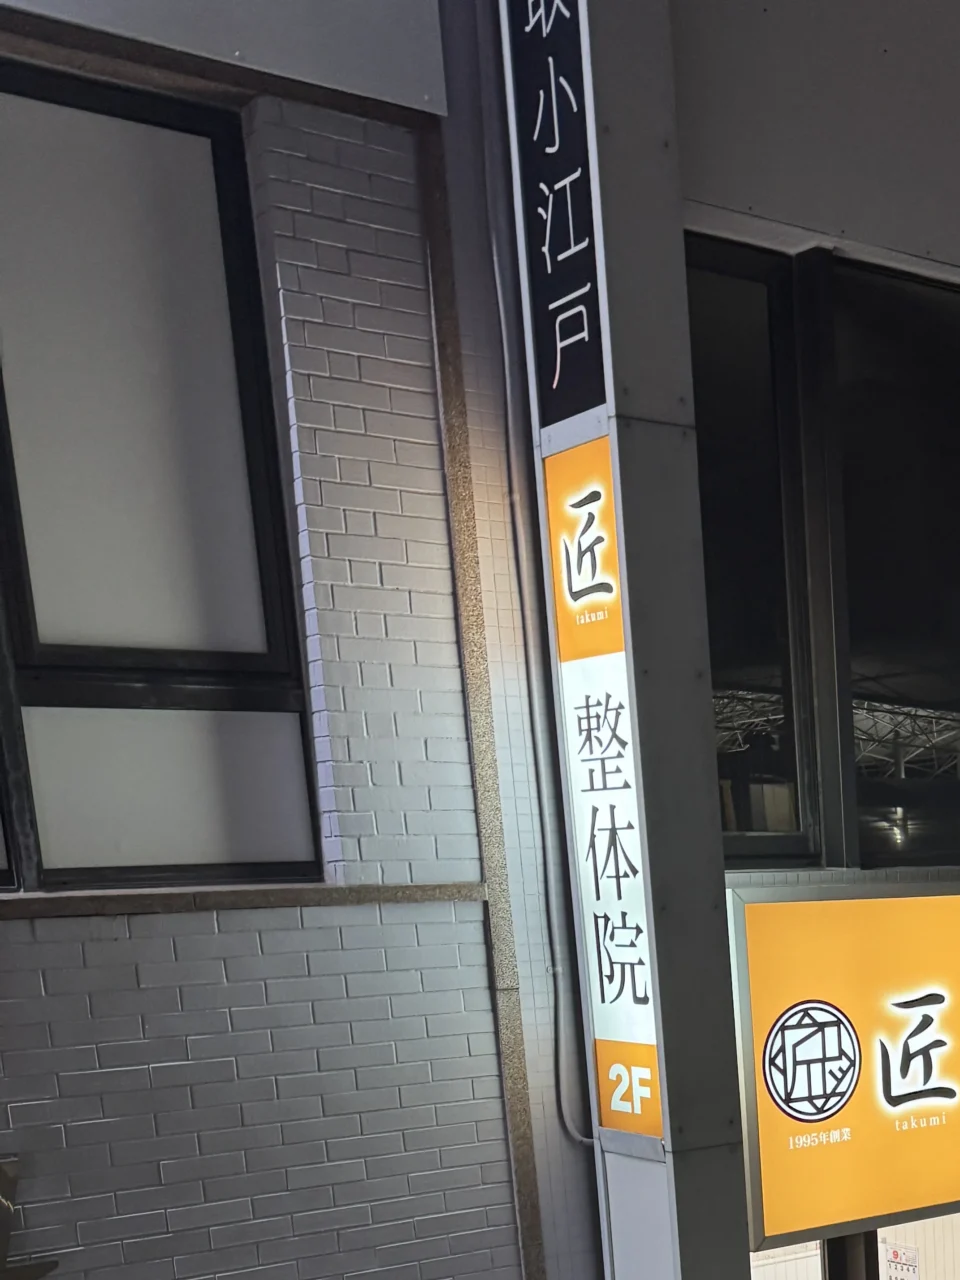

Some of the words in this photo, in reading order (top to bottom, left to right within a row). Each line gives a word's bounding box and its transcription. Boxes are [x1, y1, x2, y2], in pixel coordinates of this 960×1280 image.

[563, 490, 613, 602] 匠
[576, 607, 608, 625] takumi
[574, 692, 649, 1005] 整体院
[879, 993, 957, 1107] 匠
[608, 1062, 652, 1115] 2F
[788, 1128, 851, 1150] 1995年創業
[896, 1112, 947, 1131] takumi
[892, 1250, 899, 1260] 9
